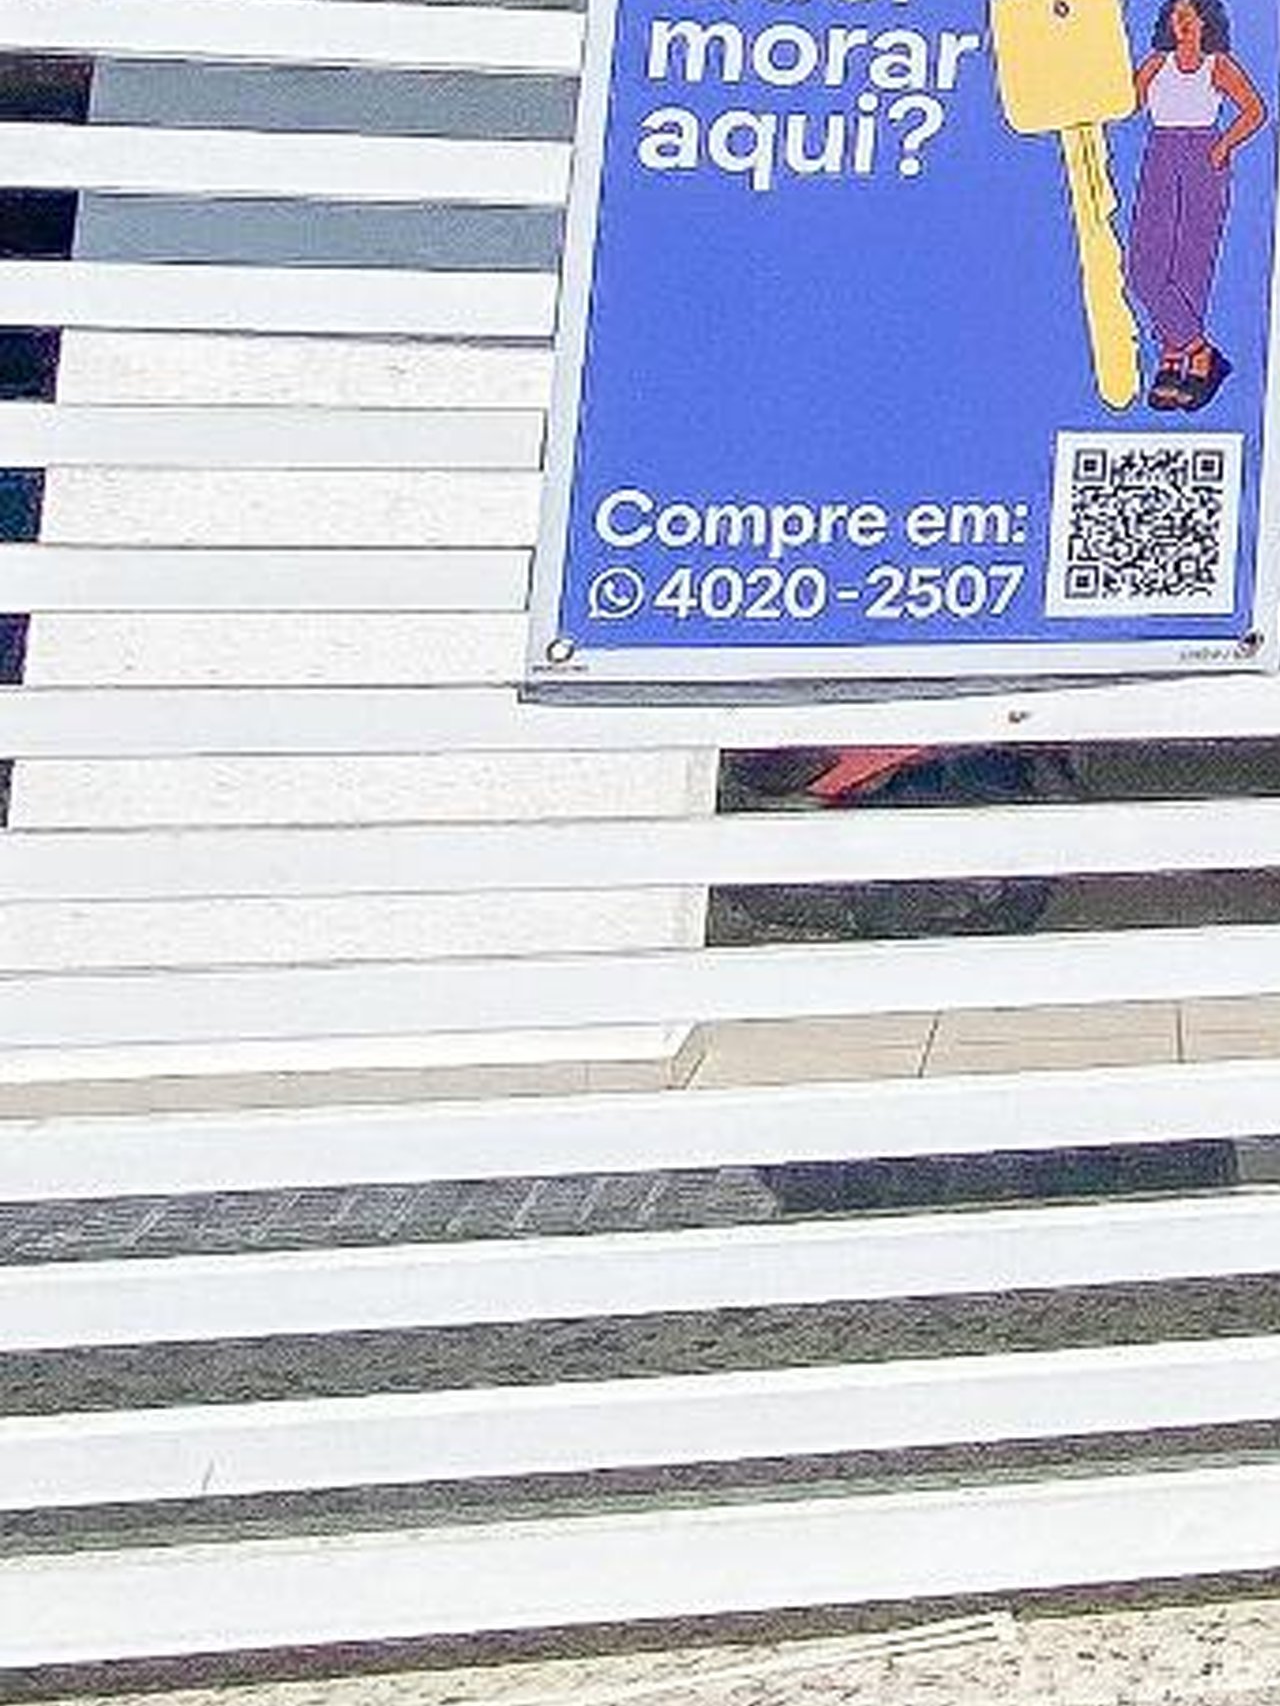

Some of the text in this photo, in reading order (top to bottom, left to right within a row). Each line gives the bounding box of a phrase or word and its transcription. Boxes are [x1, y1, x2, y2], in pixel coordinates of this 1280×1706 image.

[646, 14, 980, 92] morar
[637, 94, 946, 192] aqui?
[595, 489, 1028, 559] Compre em:
[655, 564, 1026, 620] 4020-2507
